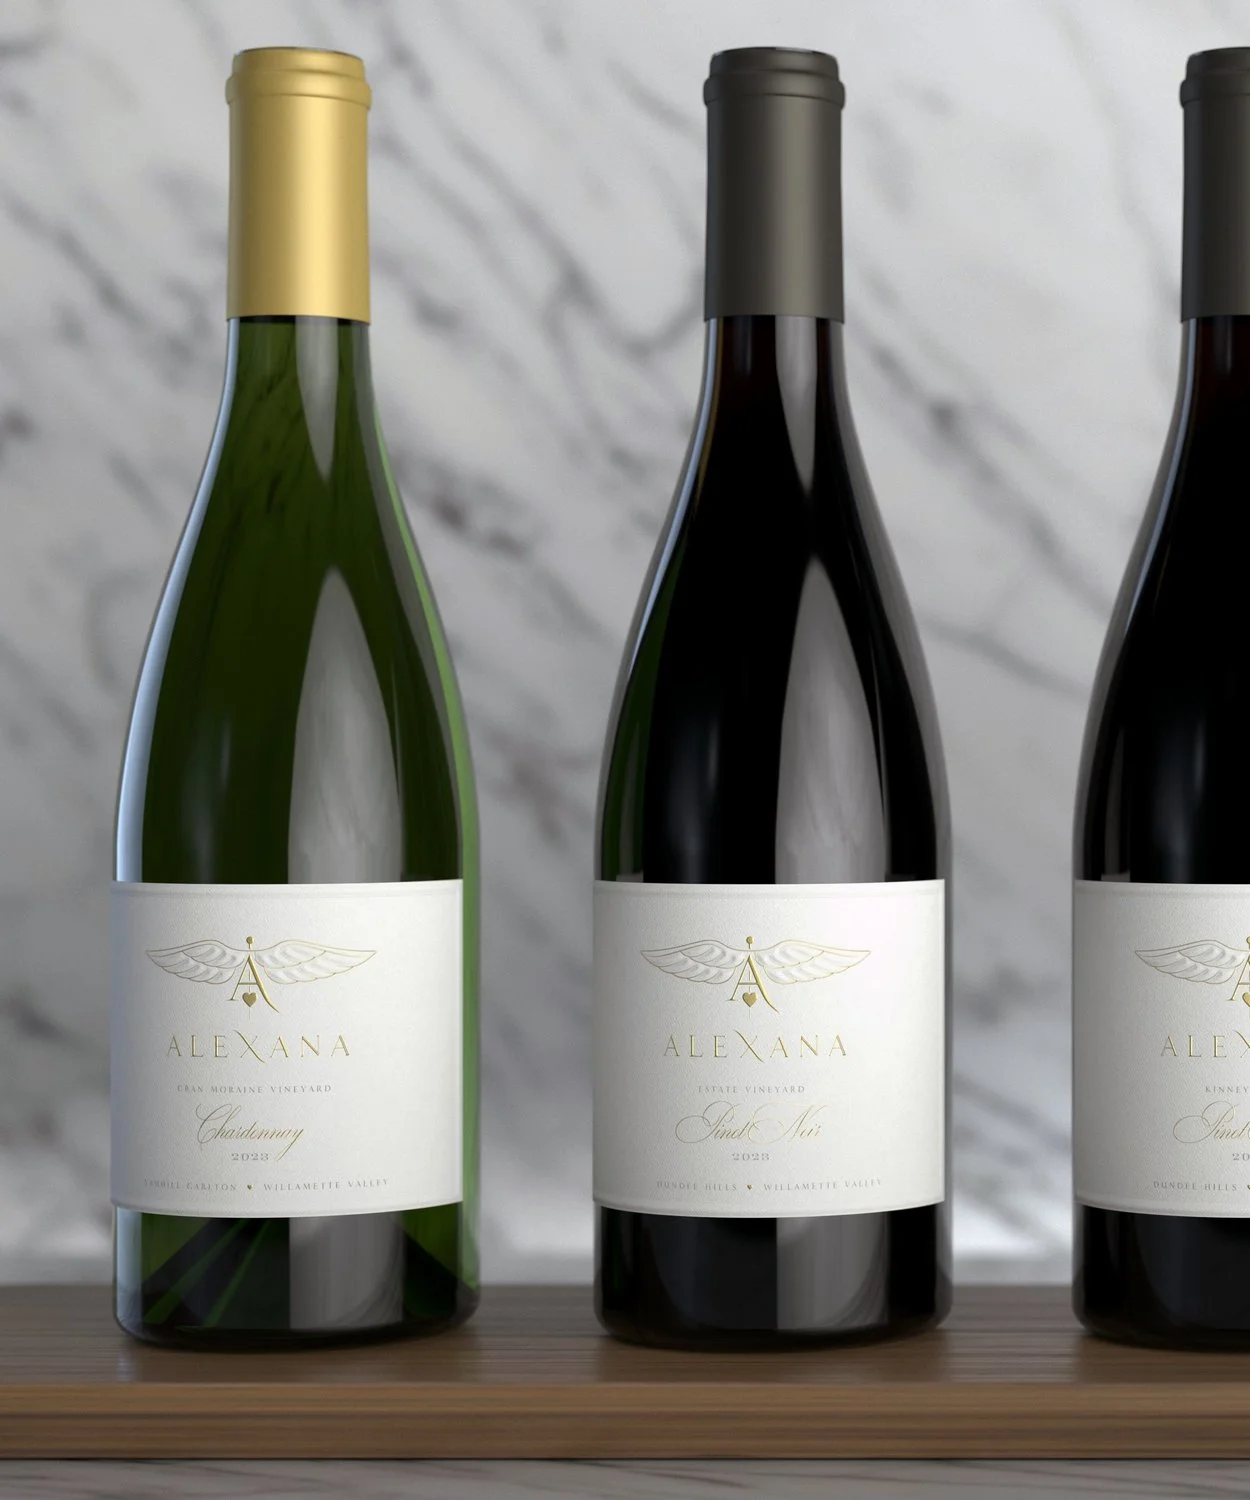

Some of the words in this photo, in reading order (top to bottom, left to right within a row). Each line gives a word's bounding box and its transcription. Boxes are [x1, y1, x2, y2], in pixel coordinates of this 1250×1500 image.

[167, 1030, 350, 1063] ALEXANA
[664, 1029, 847, 1063] ALEXANA
[210, 1085, 263, 1094] MORAINE
[270, 1084, 332, 1093] VINEYARD
[698, 1085, 738, 1094] ESTATE
[745, 1085, 806, 1094] VINEYARD
[1205, 1085, 1249, 1094] KINNEY
[675, 1100, 750, 1144] Pinot
[748, 1101, 829, 1144] Noir
[1173, 1100, 1250, 1144] Pinot
[196, 1103, 304, 1161] Chardonnay
[231, 1153, 269, 1162] 2023
[731, 1153, 769, 1162] 2023
[263, 1181, 341, 1191] WILLAMETTE
[348, 1178, 389, 1188] VALLEY
[705, 1183, 738, 1192] HILLS
[763, 1181, 838, 1191] WILLAMETTE
[844, 1178, 882, 1188] VALLEY
[1153, 1181, 1198, 1191] DUNDEE
[1204, 1184, 1238, 1192] HILLS
